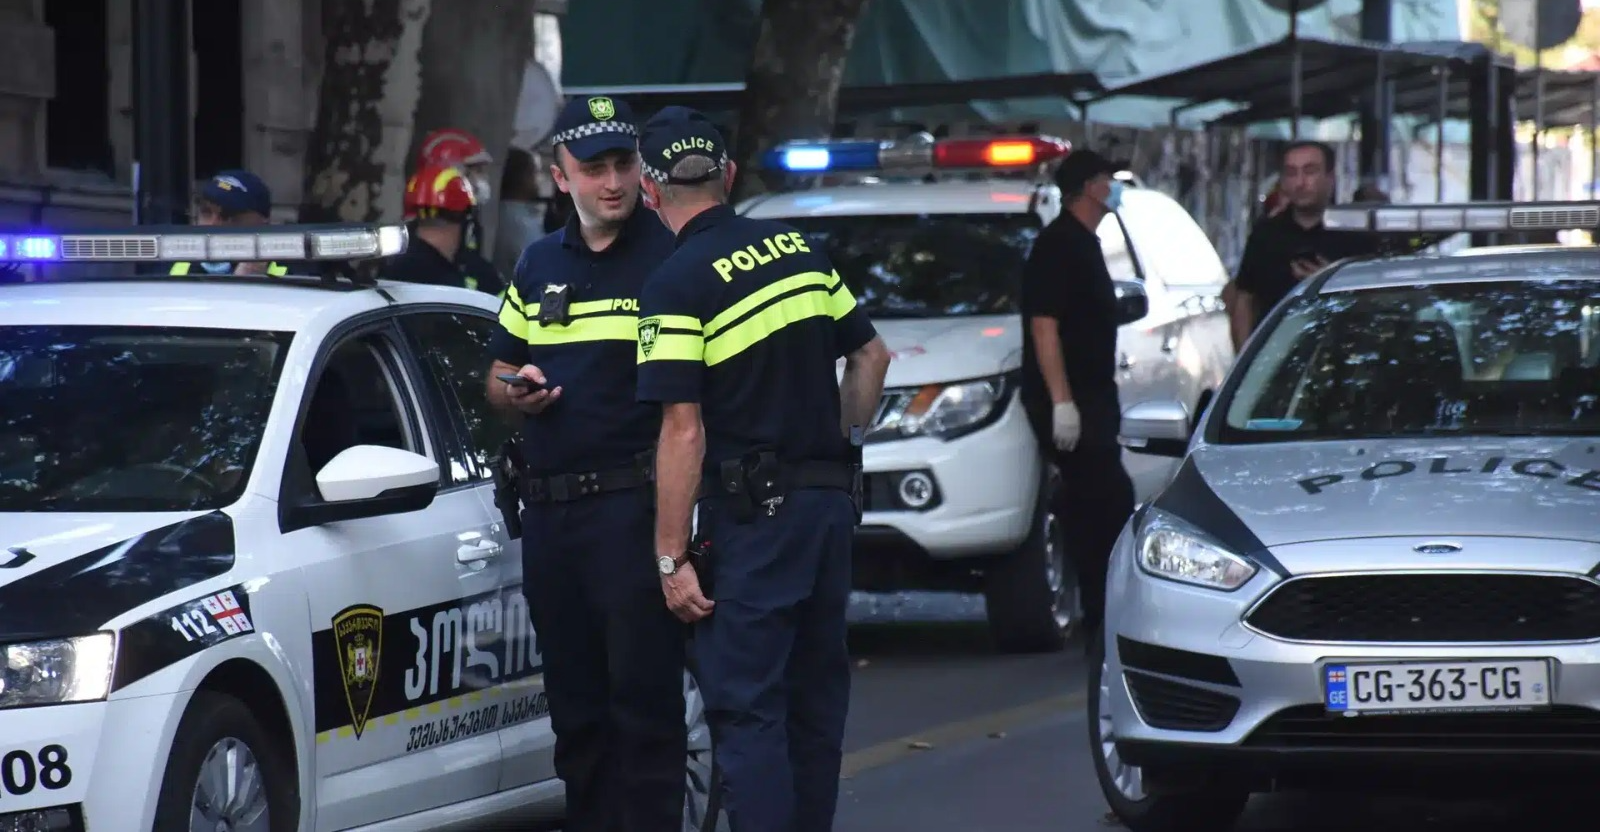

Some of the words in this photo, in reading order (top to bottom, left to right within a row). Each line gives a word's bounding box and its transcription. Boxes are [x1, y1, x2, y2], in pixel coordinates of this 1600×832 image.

[662, 136, 714, 160] POLICE
[712, 231, 811, 283] POLICE
[171, 609, 217, 642] 112
[1329, 690, 1347, 705] GE
[1353, 667, 1521, 703] CG-363-CG
[501, 691, 549, 726] საქართ
[0, 744, 72, 799] 08
